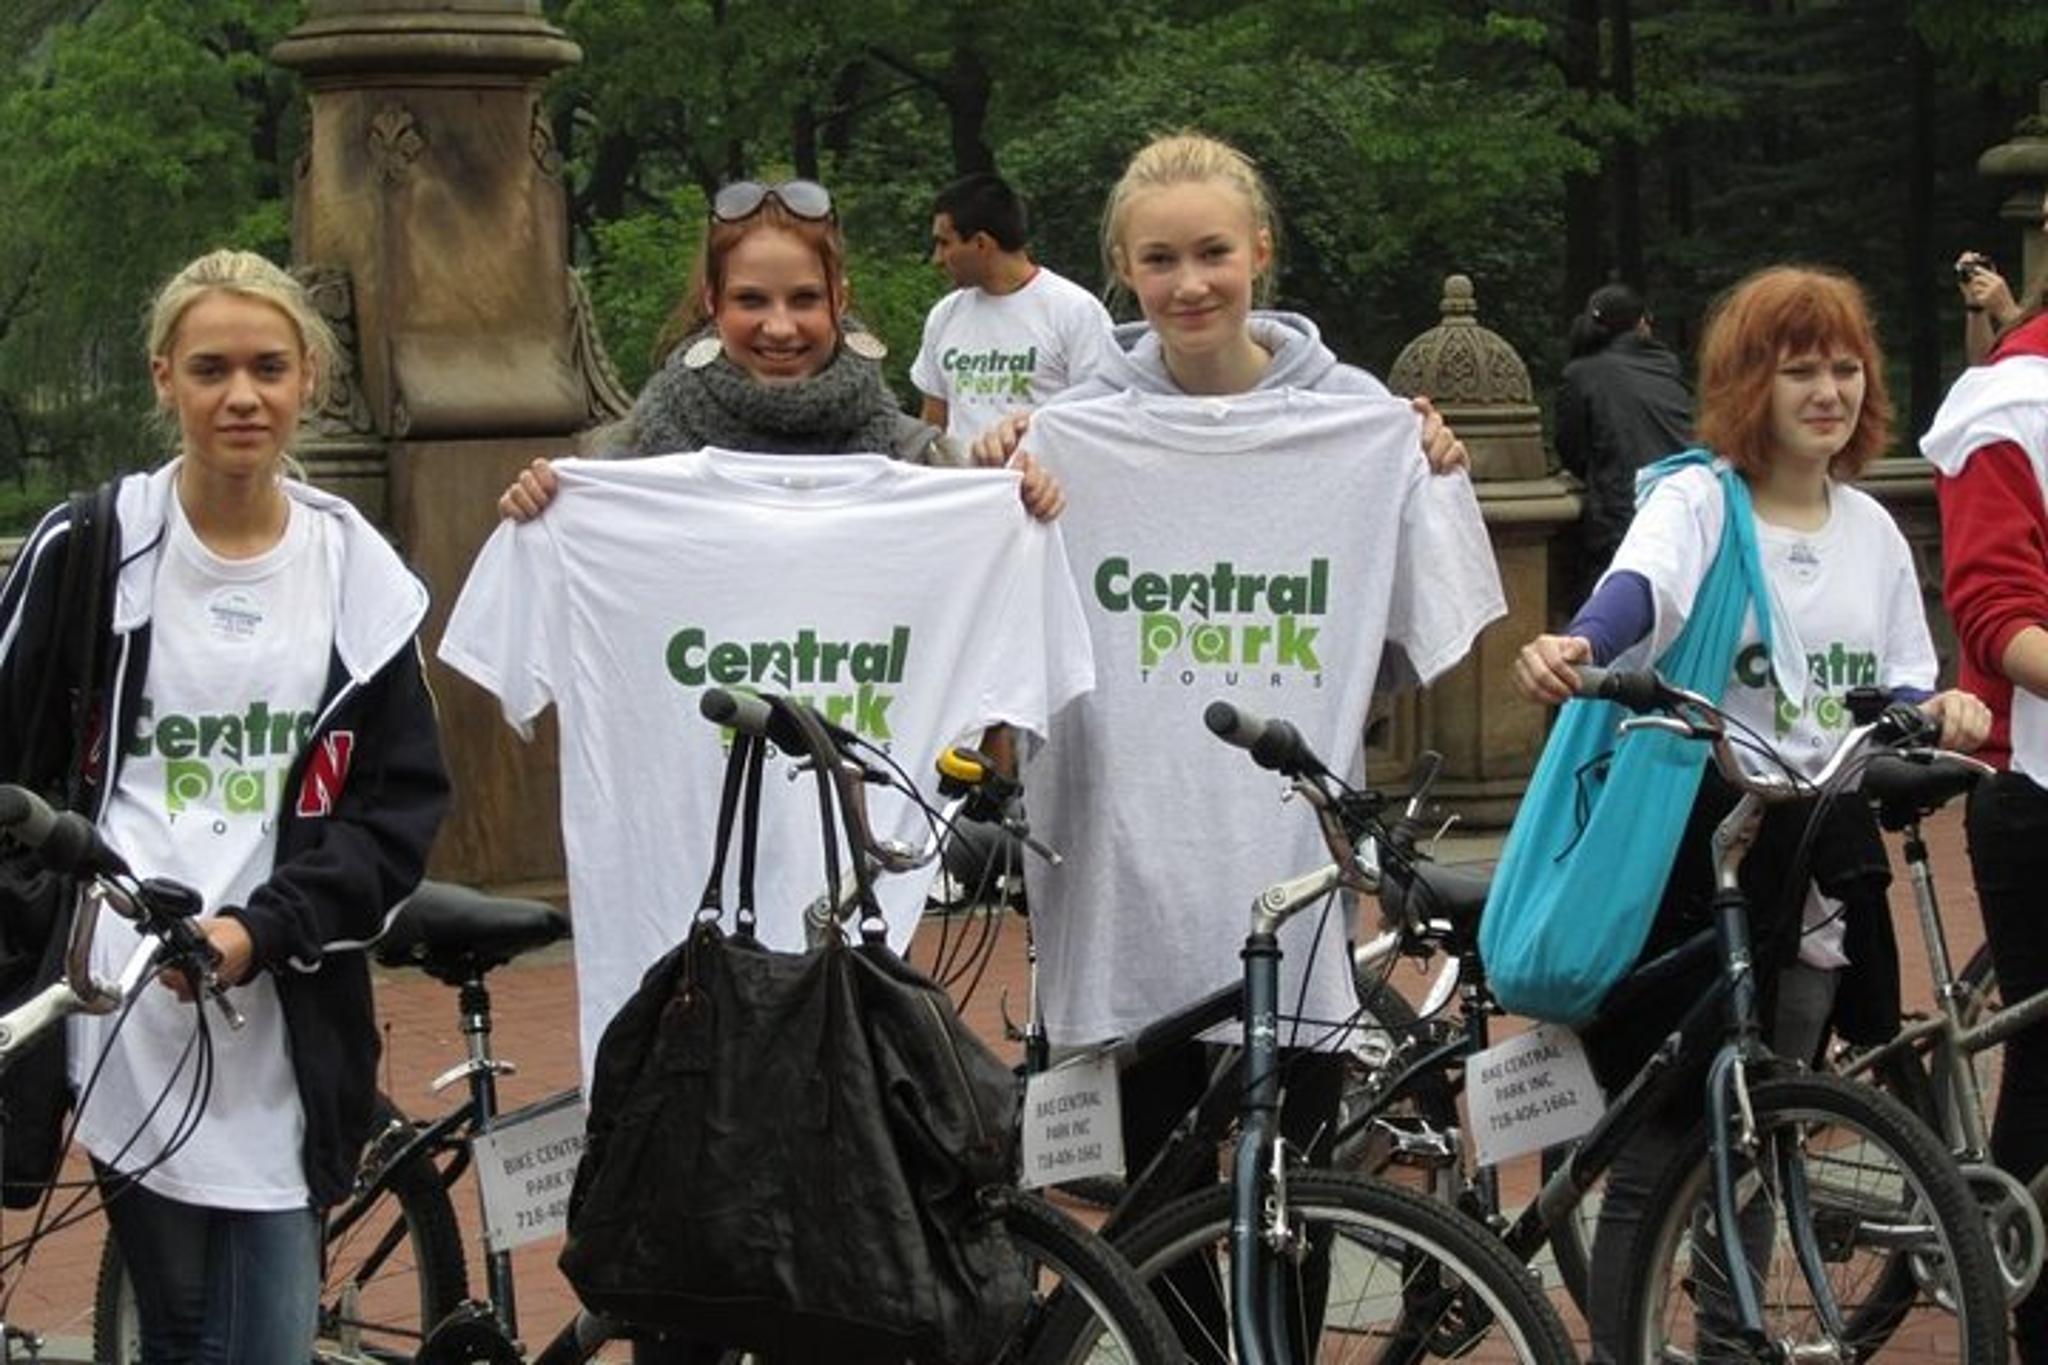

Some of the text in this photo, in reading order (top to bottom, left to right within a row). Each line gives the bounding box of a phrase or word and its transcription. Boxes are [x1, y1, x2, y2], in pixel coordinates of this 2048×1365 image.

[942, 346, 1038, 373] Central
[1095, 557, 1329, 620] Central
[665, 625, 911, 690] Central
[1142, 669, 1322, 688] TOURS
[297, 731, 353, 816] N
[1504, 1046, 1563, 1074] CENTRAL
[1495, 1080, 1527, 1101] PARK
[503, 1151, 535, 1175] BIKE
[525, 1170, 563, 1198] PARK
